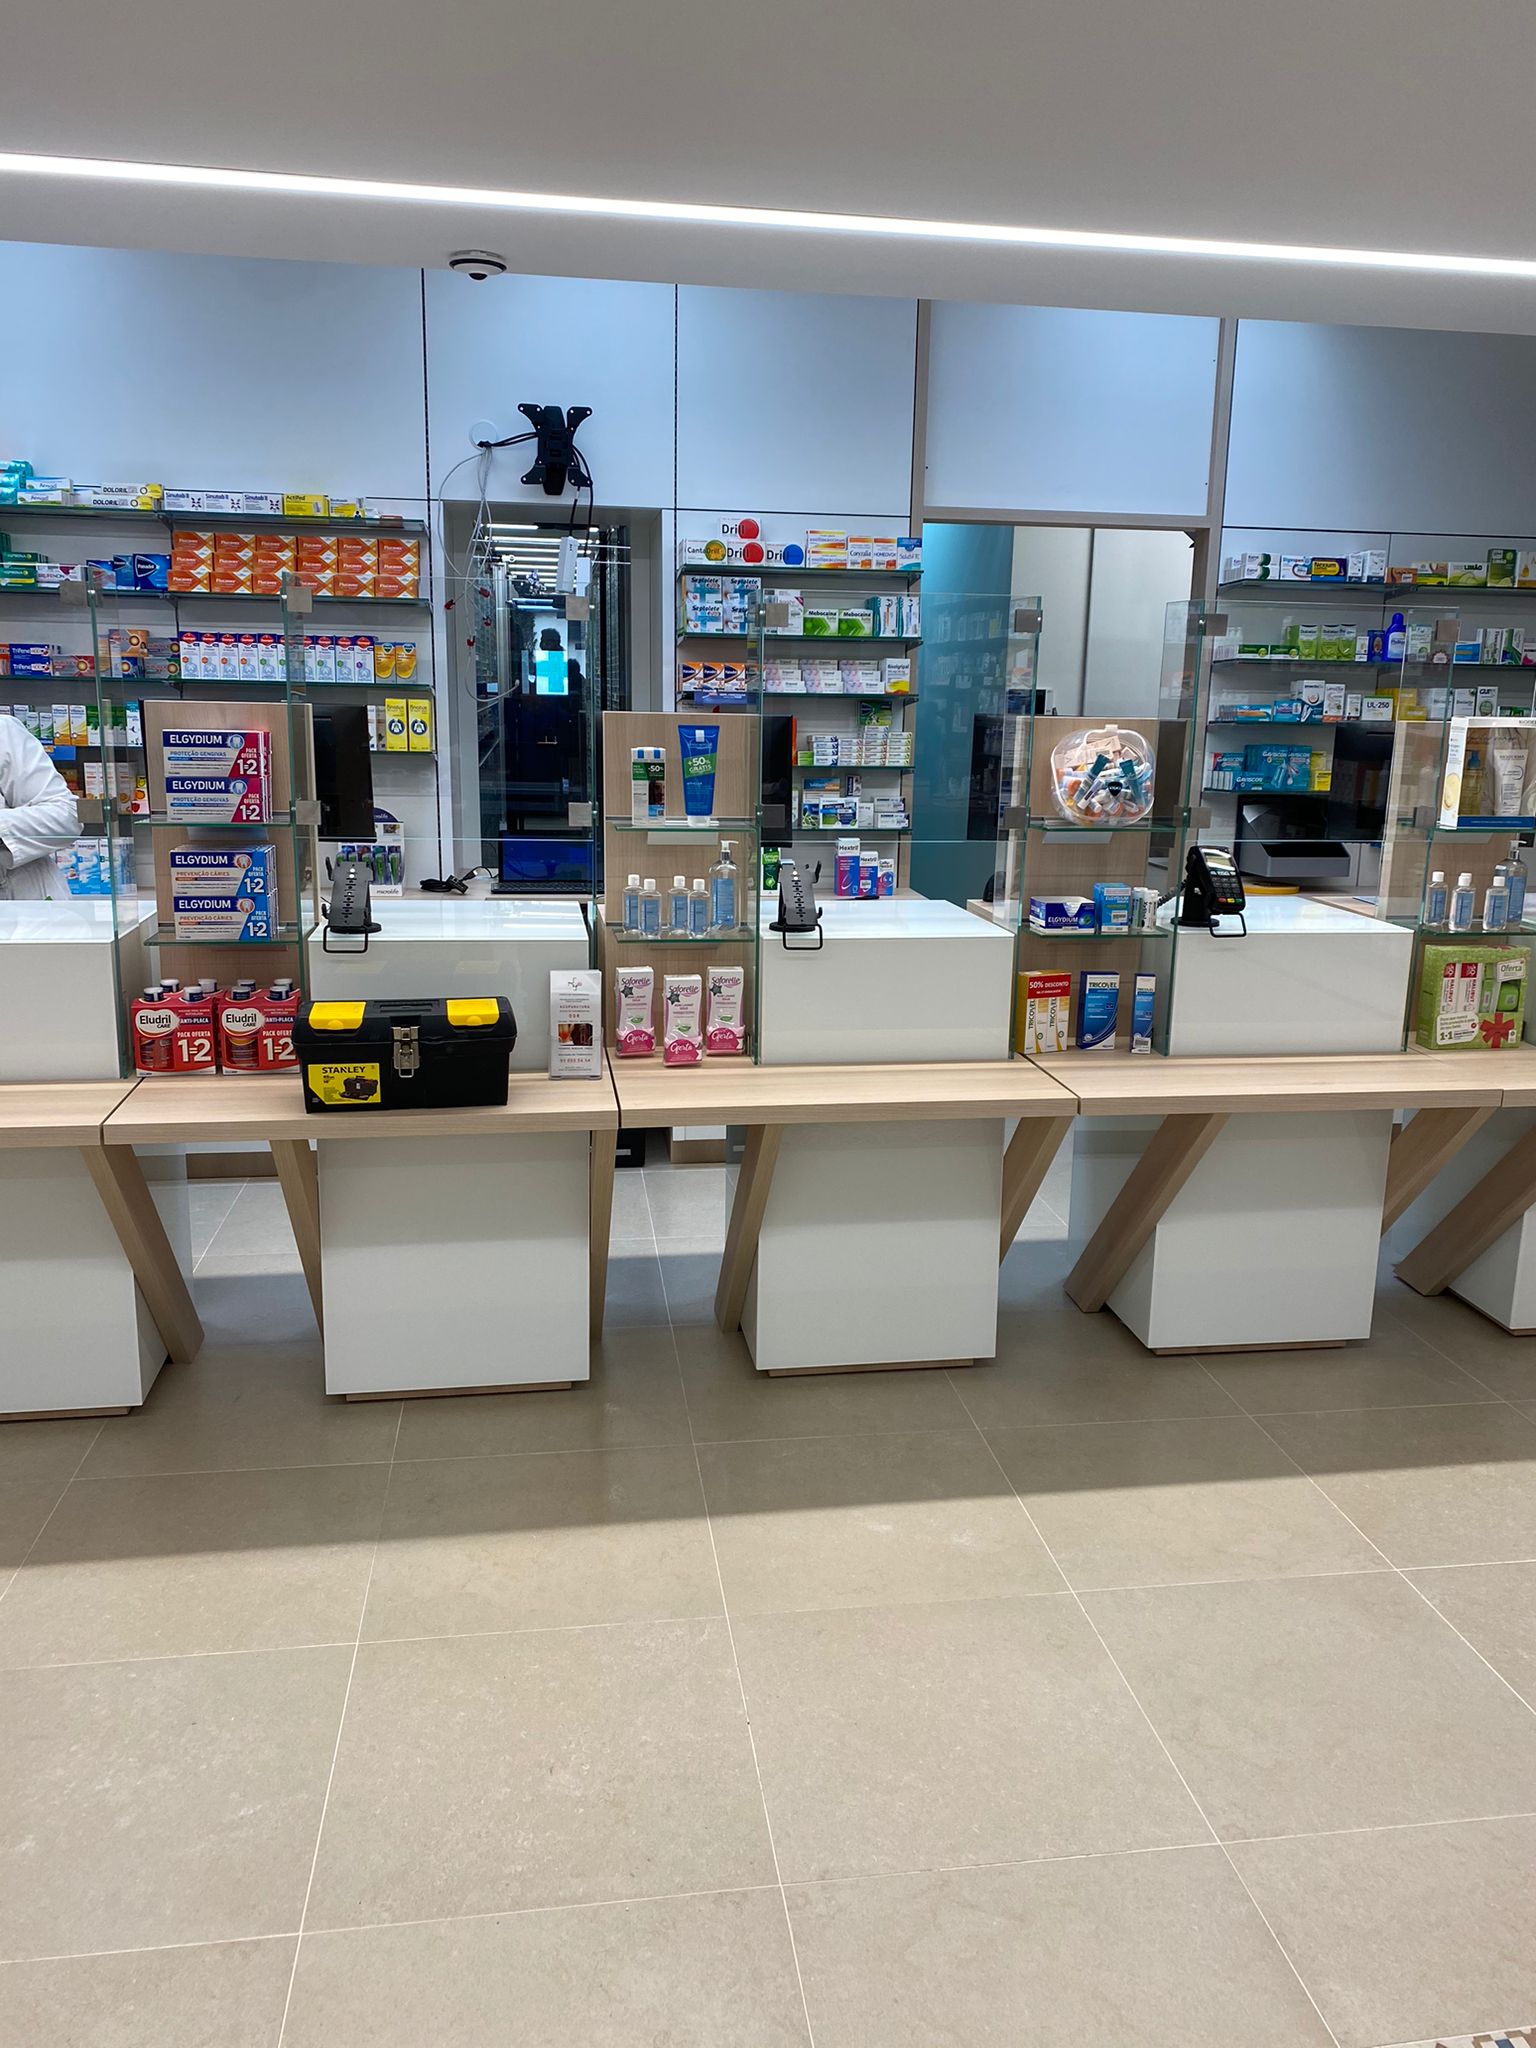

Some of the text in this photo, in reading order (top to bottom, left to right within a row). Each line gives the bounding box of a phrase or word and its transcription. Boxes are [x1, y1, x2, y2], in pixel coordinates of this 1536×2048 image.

[170, 734, 222, 745] ELGYDIUM
[237, 759, 258, 775] 1=2
[172, 780, 225, 791] ELGYDIUM
[240, 805, 261, 821] 1=2
[176, 855, 228, 865] ELGYDIUM
[244, 878, 265, 893] 1=2
[178, 900, 231, 909] ELGYDIUM
[247, 922, 268, 937] 1=2
[1500, 964, 1522, 973] Oferta
[621, 977, 652, 986] Saforelle
[711, 976, 742, 985] Saforelle
[1029, 981, 1044, 989] 50%
[668, 985, 700, 994] Saforelle
[1089, 982, 1117, 990] TRICOVEL
[139, 1015, 172, 1025] Eludril
[225, 1014, 257, 1023] Eludril
[178, 1039, 212, 1062] 1=2
[263, 1038, 297, 1061] 1=2
[322, 1066, 366, 1074] STANLEY
